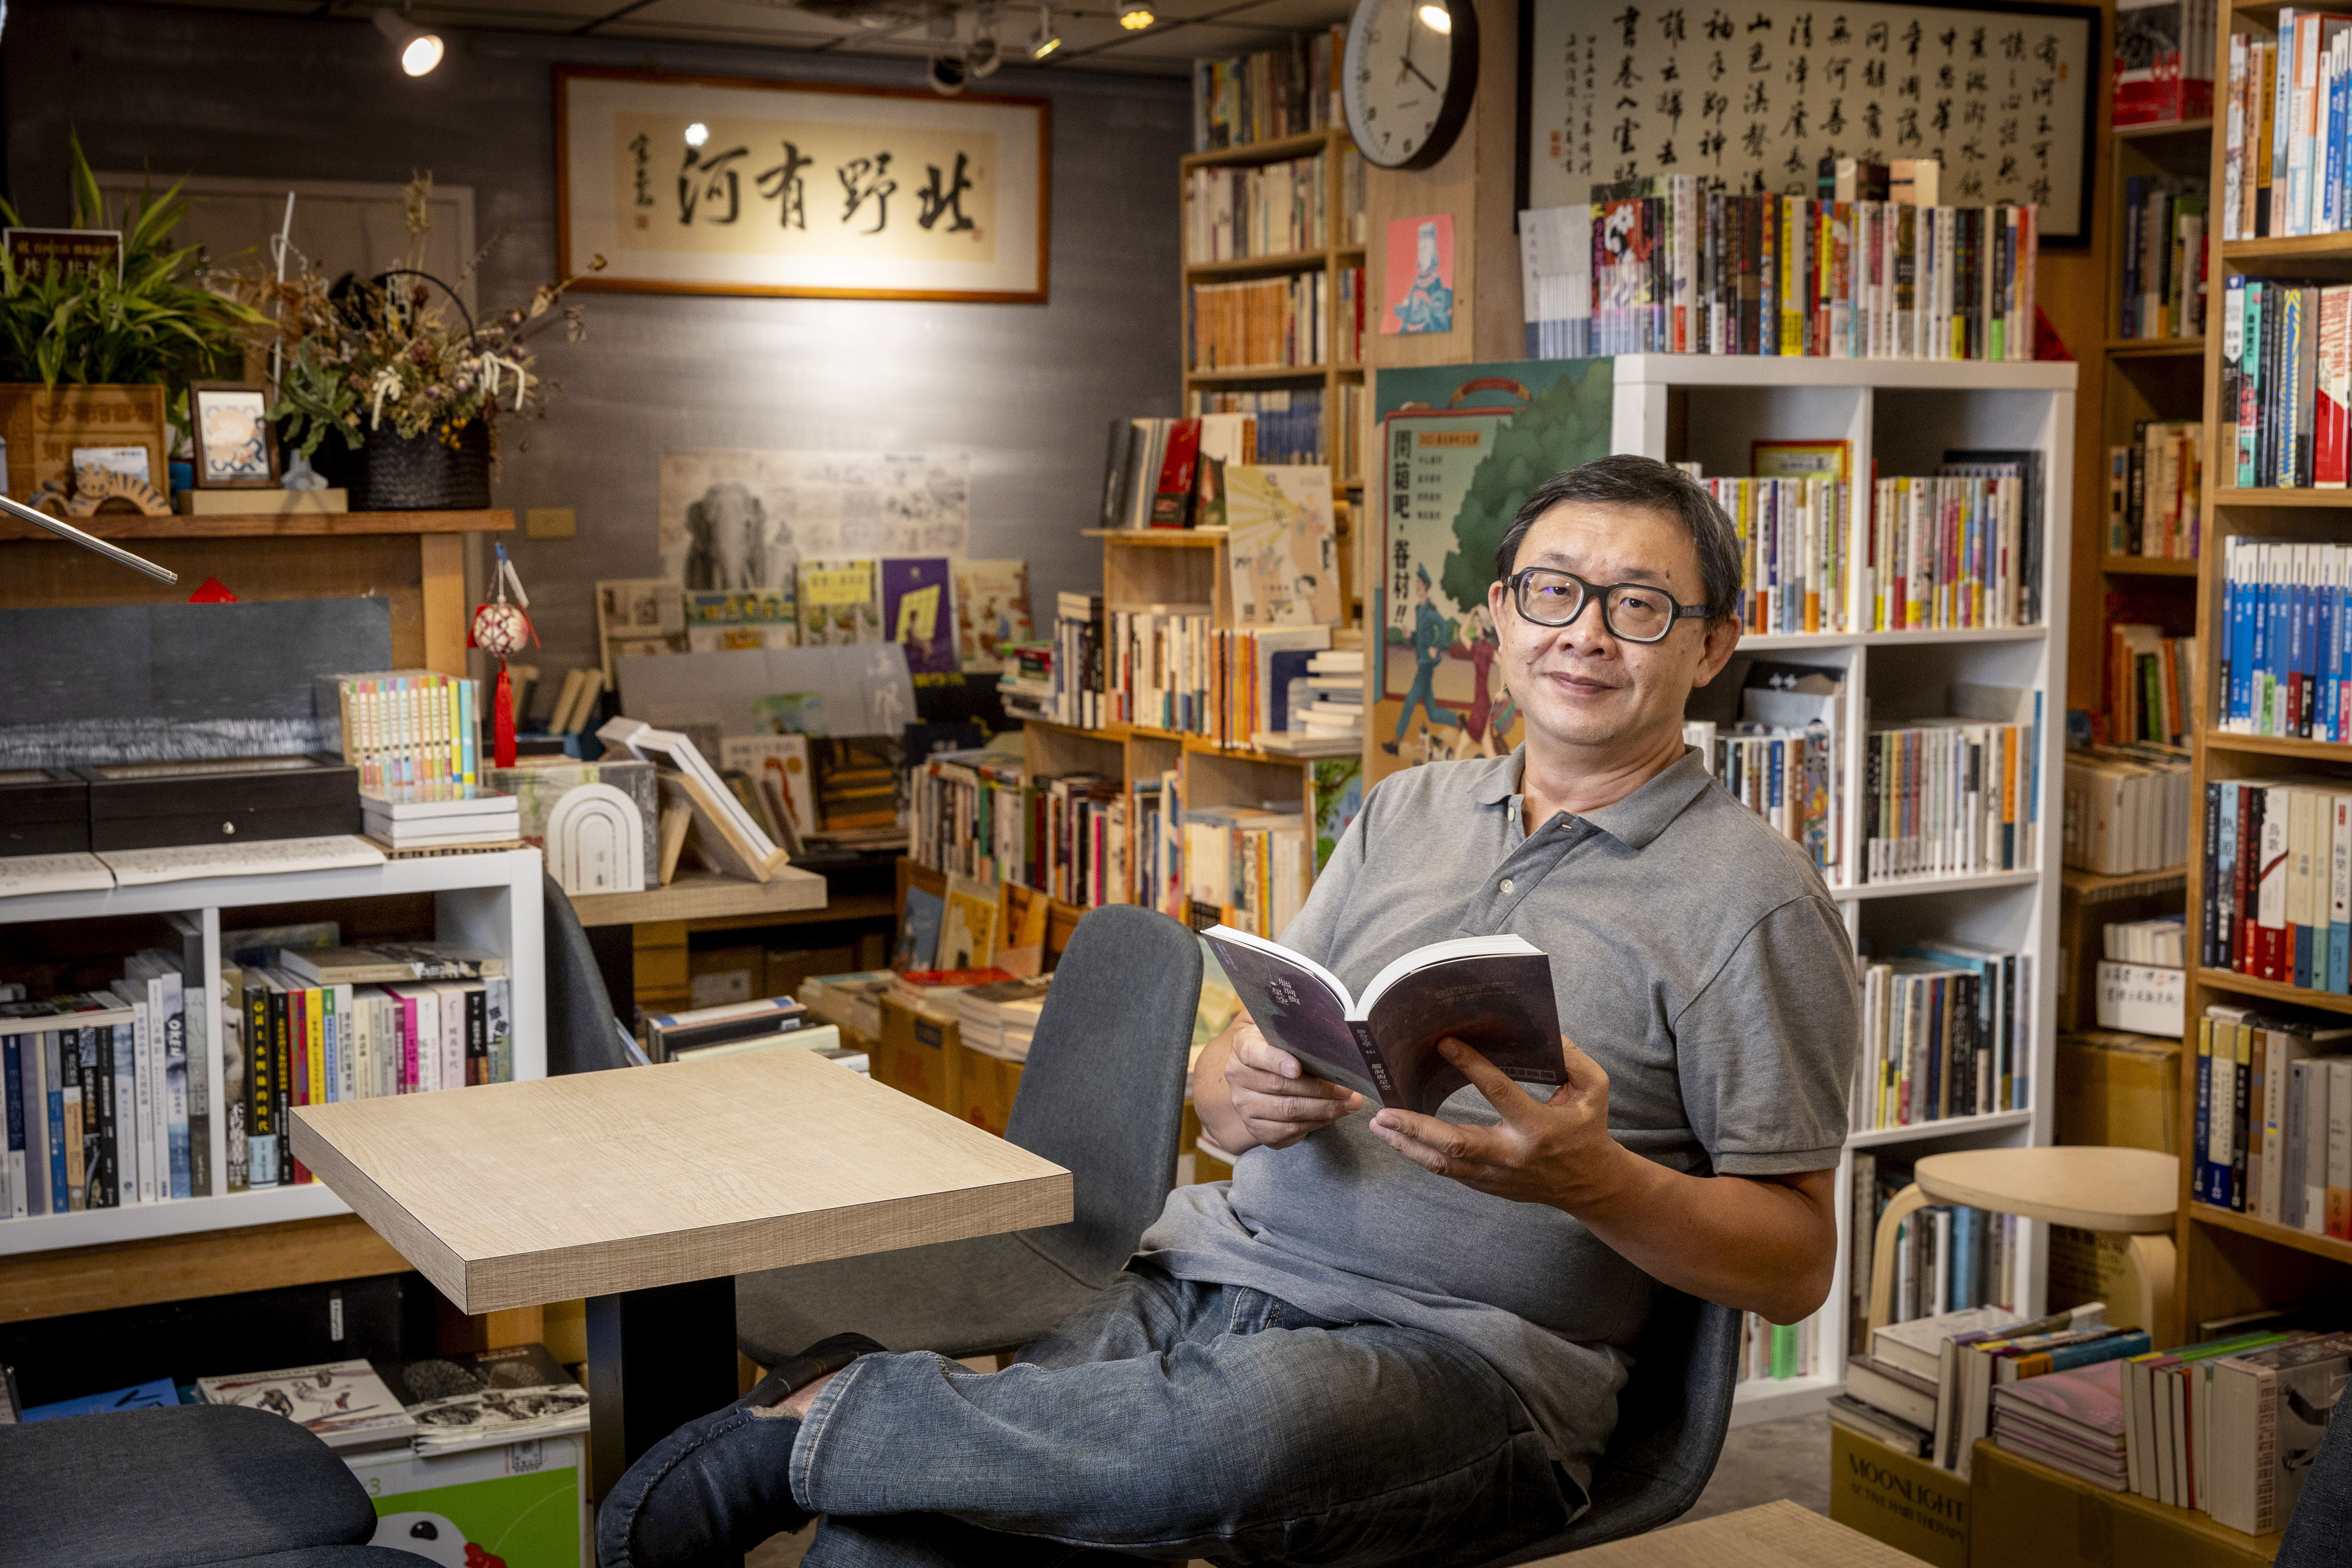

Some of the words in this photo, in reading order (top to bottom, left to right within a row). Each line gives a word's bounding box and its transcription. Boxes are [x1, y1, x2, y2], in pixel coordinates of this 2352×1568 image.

[1381, 132, 1390, 146] 7
[1403, 138, 1412, 153] 6
[1272, 987, 1289, 1005] 星空
[1278, 978, 1300, 1005] 腦洞與
[167, 1018, 183, 1058] OKEN
[1372, 1064, 1391, 1090] 腦洞與星空
[1849, 1452, 1966, 1523] MOONLIGHT
